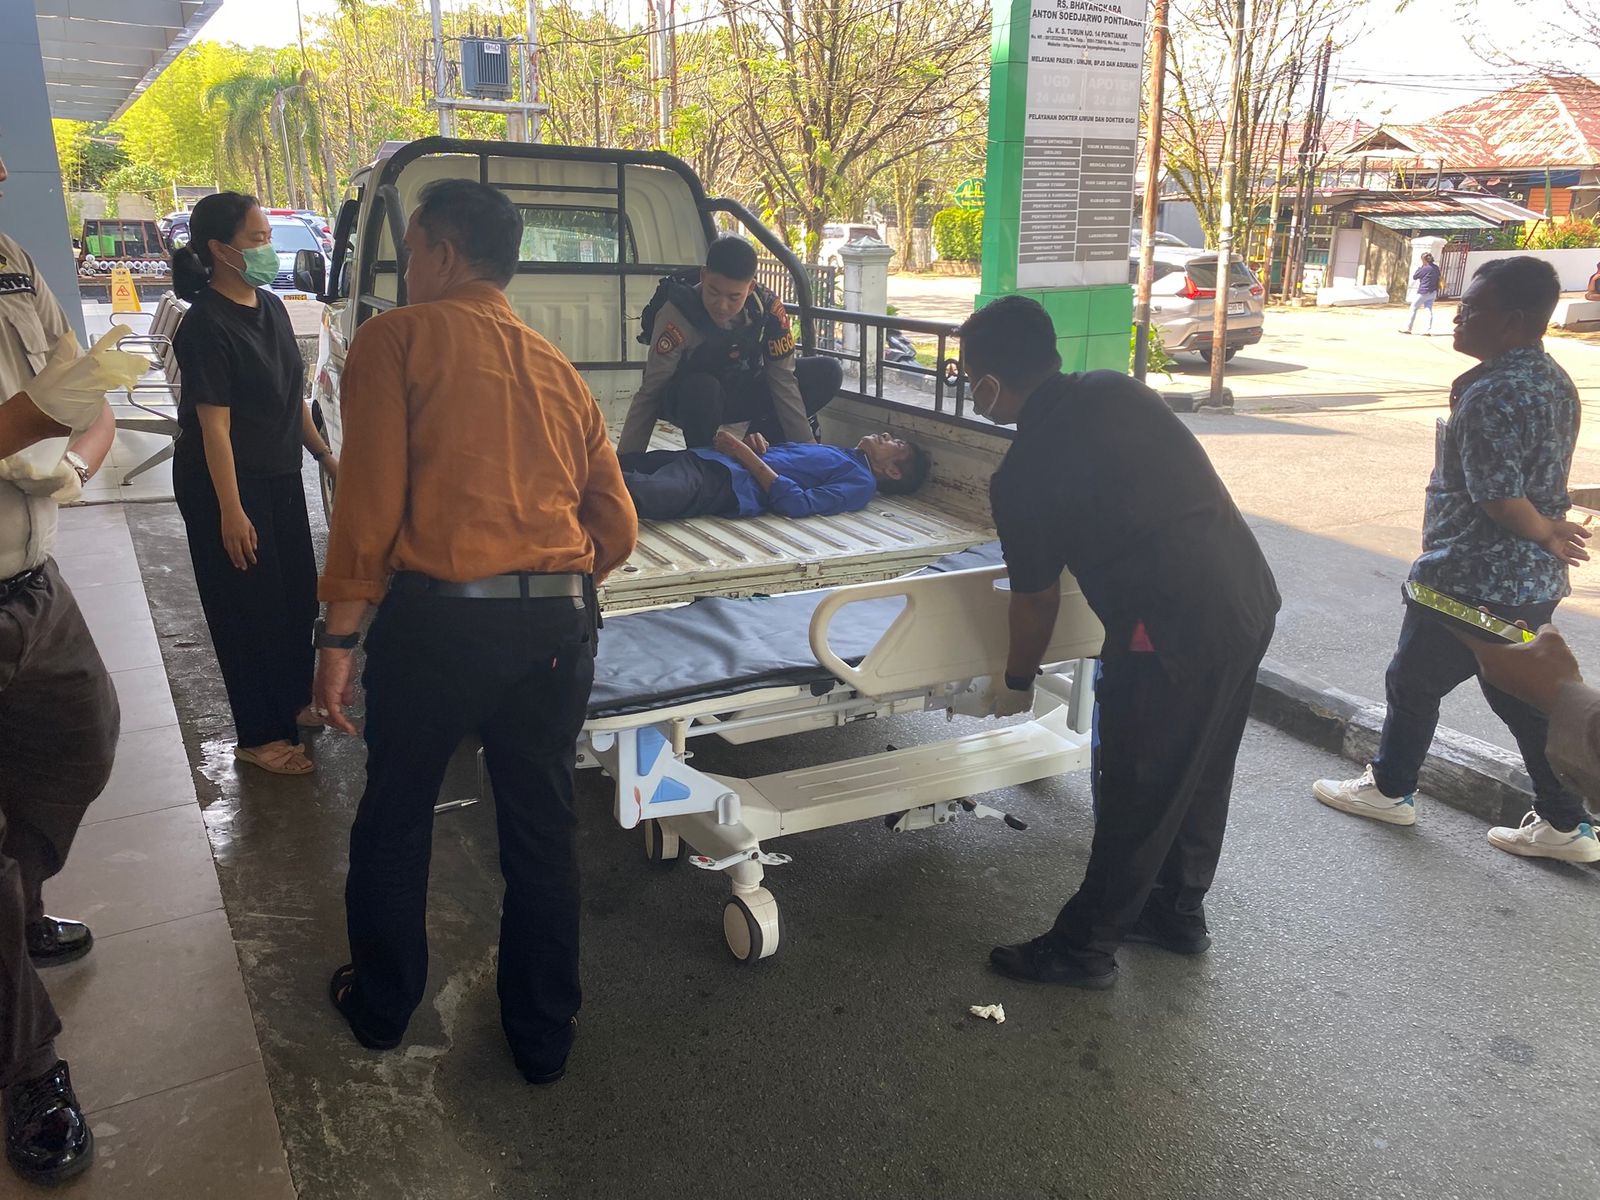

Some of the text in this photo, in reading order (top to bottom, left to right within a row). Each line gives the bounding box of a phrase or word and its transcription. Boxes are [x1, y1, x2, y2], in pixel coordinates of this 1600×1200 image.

[1057, 0, 1068, 9] RS.
[1032, 9, 1057, 20] ANTON
[1059, 11, 1102, 24] SOEDJARWO
[1101, 32, 1128, 40] PONTIANAK
[1116, 61, 1139, 69] ASURANSI
[1042, 74, 1071, 88] UGD
